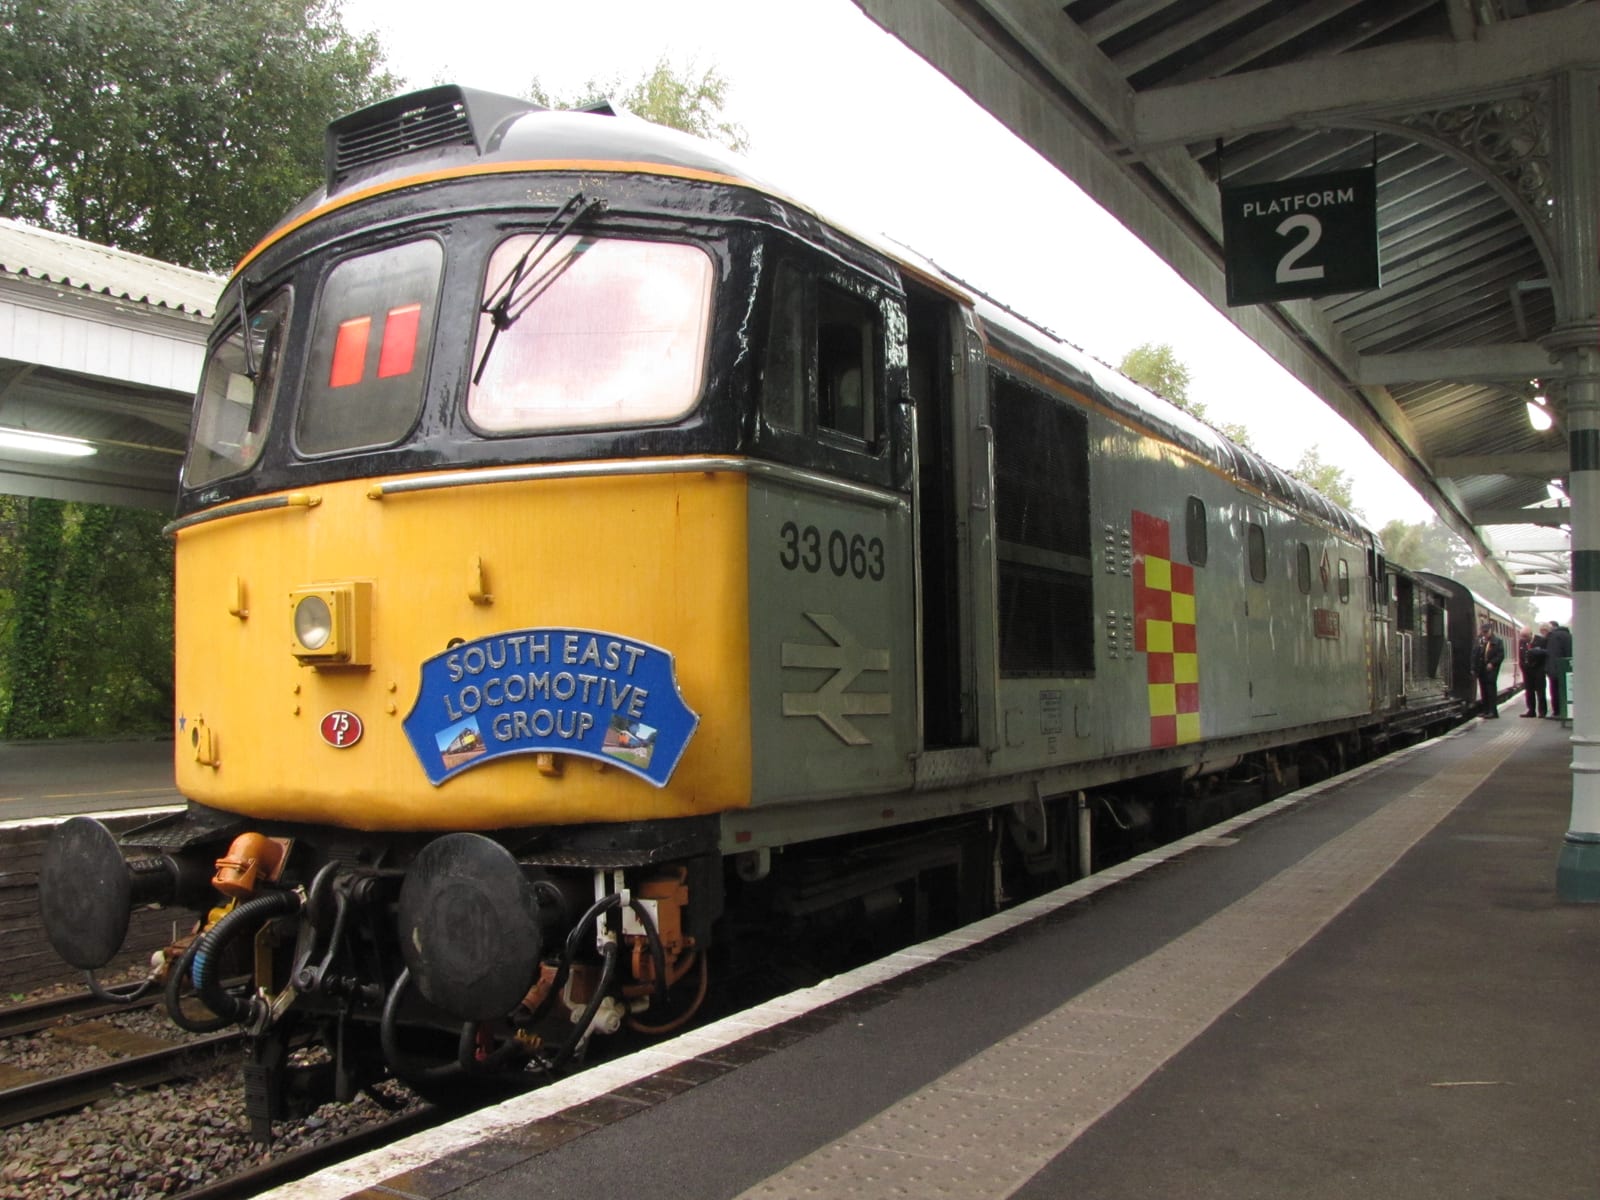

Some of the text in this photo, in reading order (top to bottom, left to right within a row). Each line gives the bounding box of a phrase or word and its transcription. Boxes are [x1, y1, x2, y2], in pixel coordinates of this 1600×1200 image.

[1243, 187, 1354, 218] PLATFORM
[1275, 213, 1324, 284] 2
[446, 634, 646, 682] SOUTH EAST
[443, 671, 648, 721] LOCOMOTIVE
[332, 714, 349, 731] 75
[337, 731, 344, 745] F
[492, 709, 594, 742] GROUP
